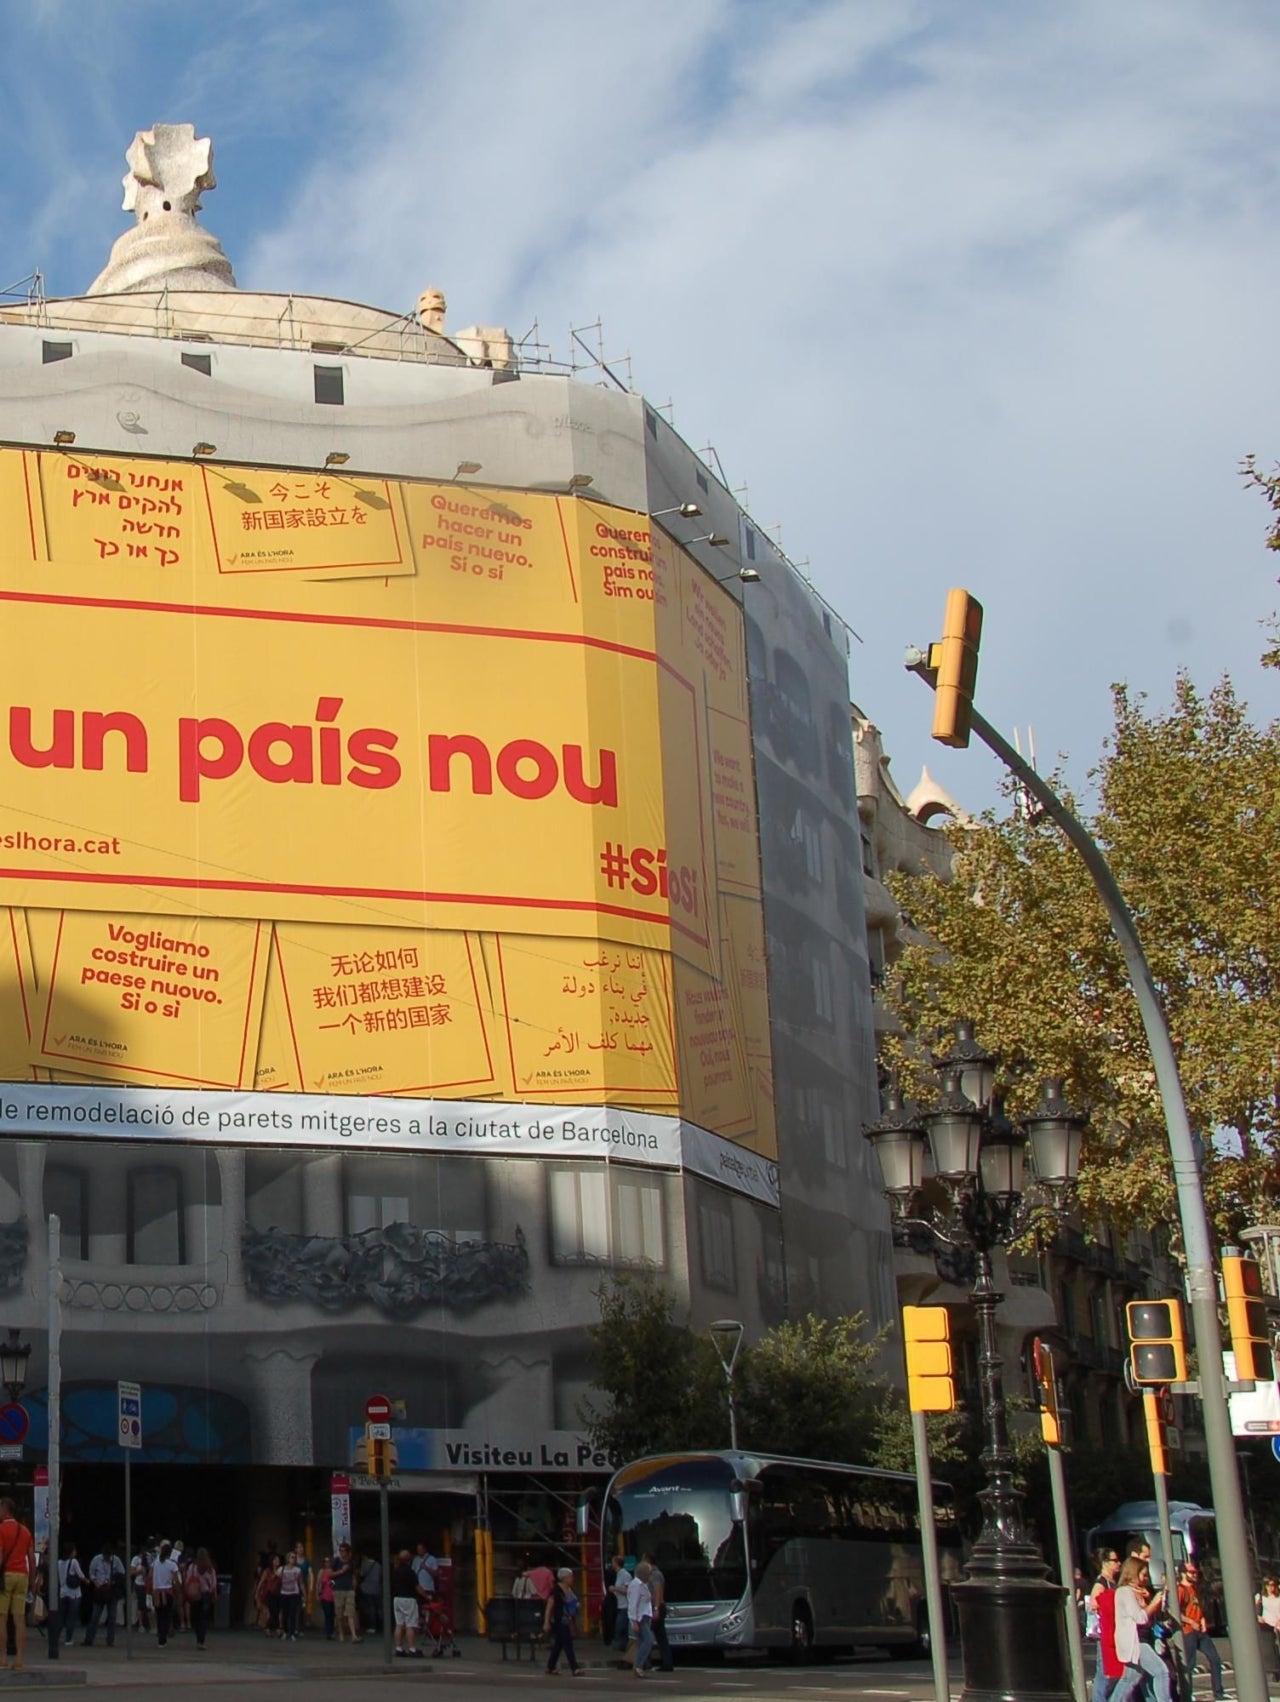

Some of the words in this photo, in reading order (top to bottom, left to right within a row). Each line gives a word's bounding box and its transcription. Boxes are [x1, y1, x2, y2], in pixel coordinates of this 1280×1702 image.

[128, 472, 183, 492] אנחנו
[269, 481, 332, 503] 今こそ
[73, 489, 110, 507] ארץ
[118, 495, 182, 516] להקים
[241, 505, 368, 532] 新国家設立を
[430, 494, 533, 530] Queremos
[122, 518, 180, 538] חדשה
[437, 514, 493, 540] hacer
[498, 531, 522, 547] un
[94, 538, 119, 559] כך
[126, 543, 148, 558] או
[154, 546, 179, 568] כך
[468, 544, 533, 568] nuevo.
[472, 564, 484, 576] o
[604, 581, 633, 598] Sim
[636, 588, 654, 600] ou
[9, 706, 148, 773] un
[179, 696, 402, 803] país
[427, 733, 619, 808] nou
[108, 923, 210, 958] Vogliamo
[91, 947, 188, 976] costruire
[193, 965, 219, 982] un
[330, 947, 419, 977] 无论如何
[81, 967, 146, 990] paese
[151, 980, 222, 1005] nuovo.
[313, 974, 448, 1009] 我们都想建设
[144, 1001, 158, 1014] o
[319, 1003, 453, 1036] 一个新的国家
[26, 1101, 174, 1126] remodelació
[182, 1106, 210, 1127] de
[218, 1109, 293, 1132] parets
[301, 1110, 401, 1136] mitgeres
[408, 1120, 422, 1135] a
[429, 1116, 448, 1137] la
[455, 1118, 521, 1140] ciutat
[528, 1119, 554, 1141] de
[562, 1121, 658, 1150] Barcelona
[446, 1443, 532, 1465] Visiteu
[541, 1445, 569, 1466] La
